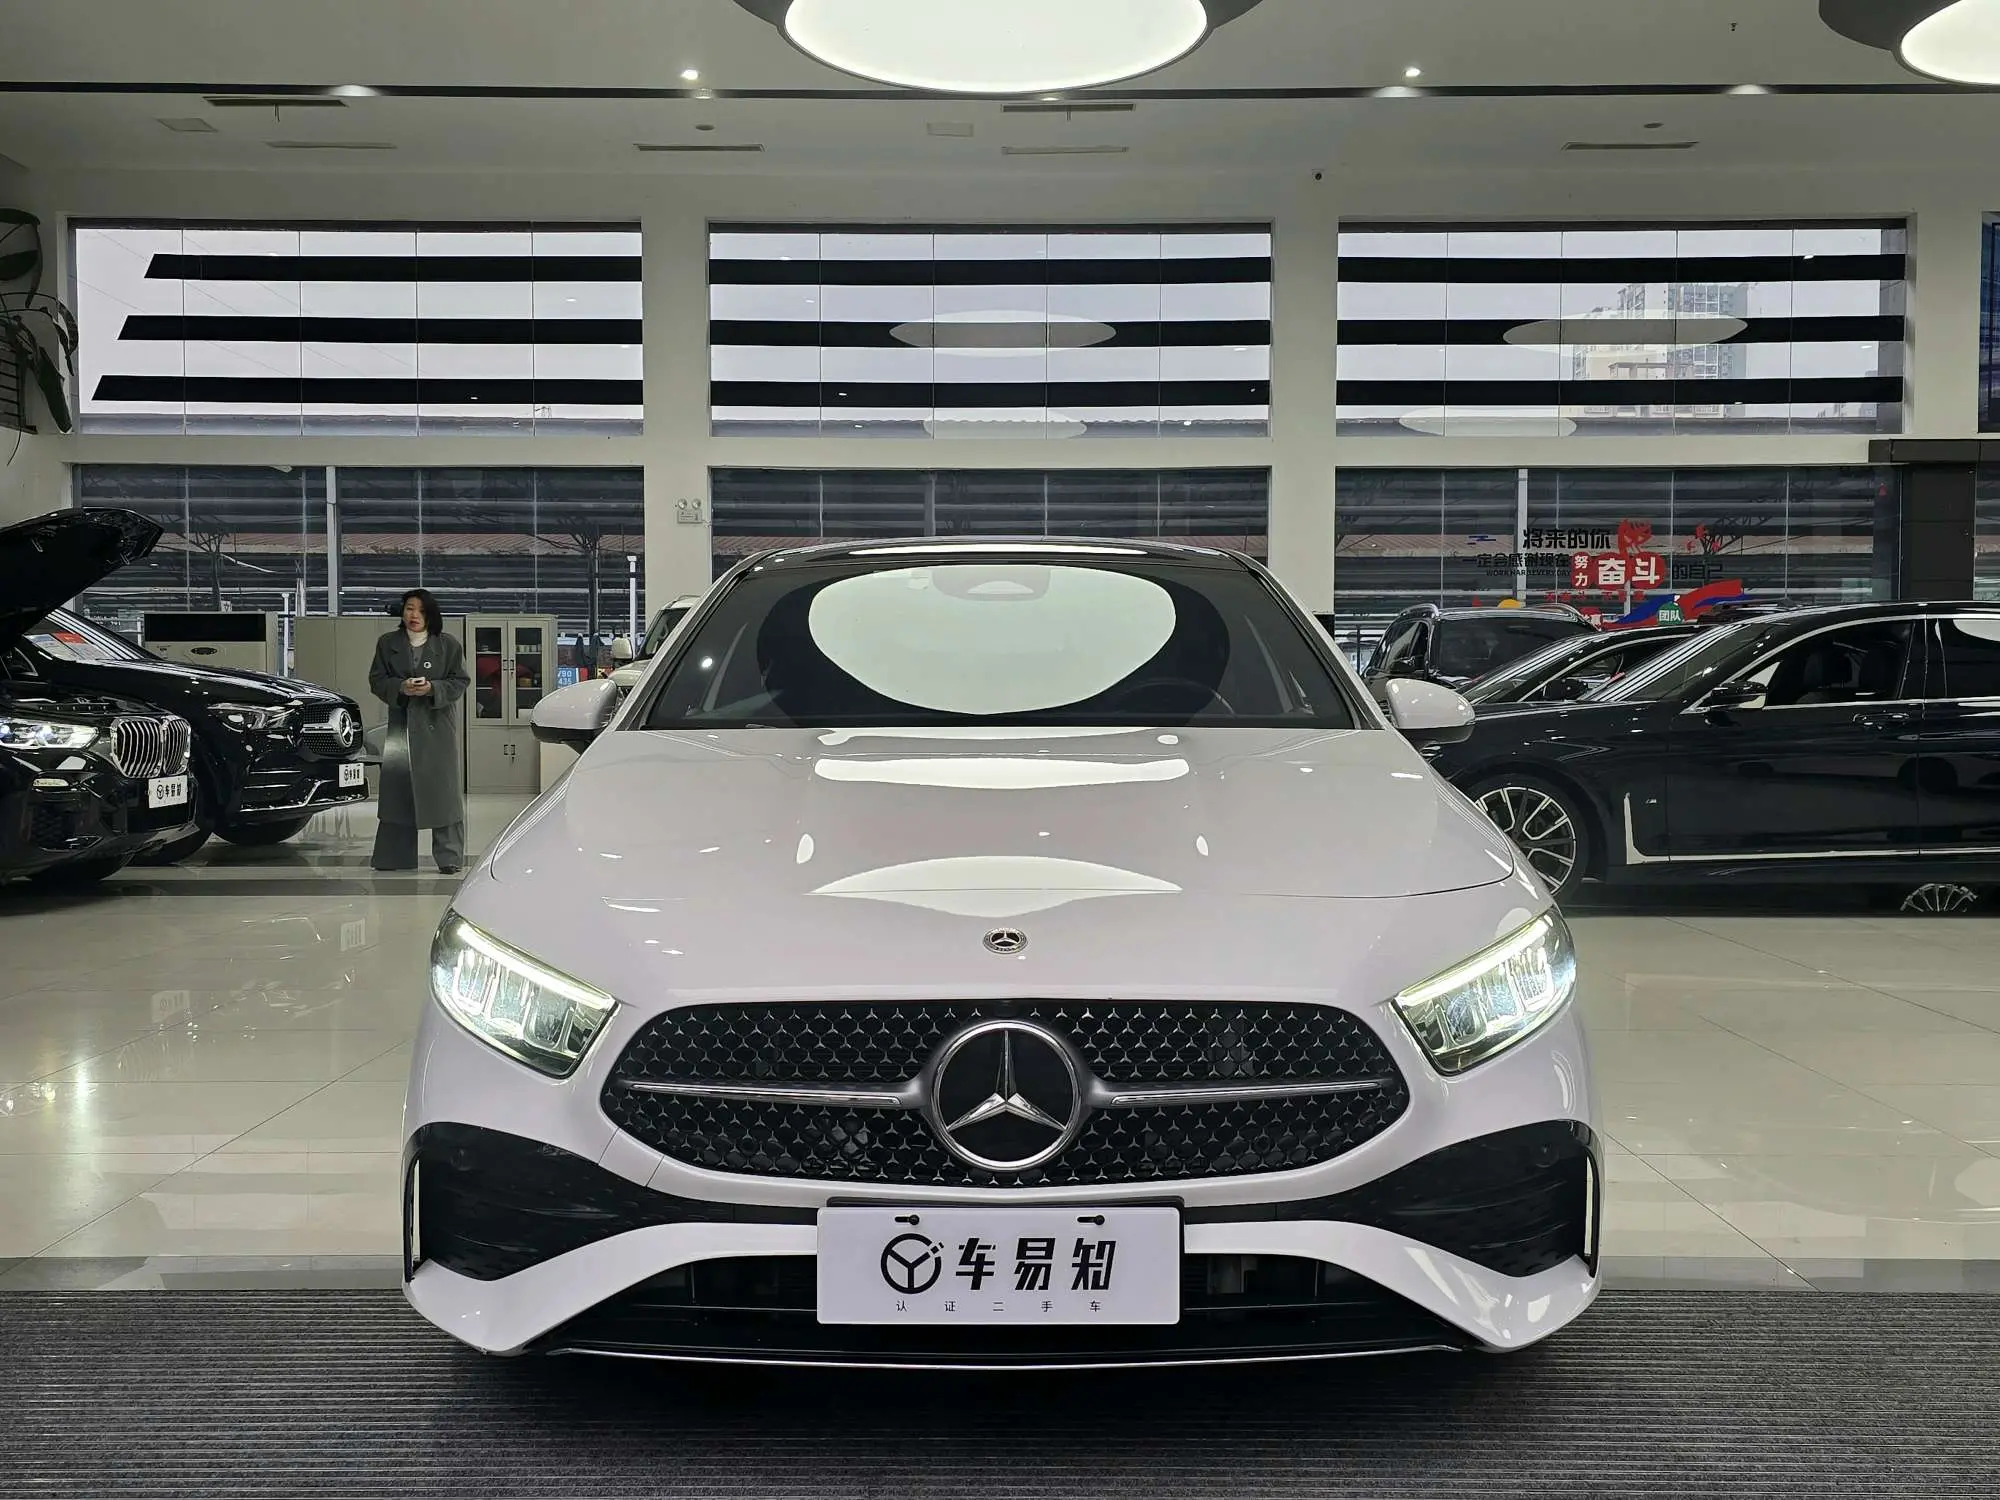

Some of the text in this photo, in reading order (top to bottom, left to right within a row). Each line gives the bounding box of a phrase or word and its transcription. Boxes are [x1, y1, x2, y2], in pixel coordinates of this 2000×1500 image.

[1523, 528, 1611, 549] 将来的你
[1574, 555, 1589, 586] 努力
[1598, 557, 1660, 585] 奋斗
[1659, 610, 1681, 621] 团队
[955, 1237, 1117, 1291] 车易知
[896, 1300, 1102, 1312] 认证二手车
